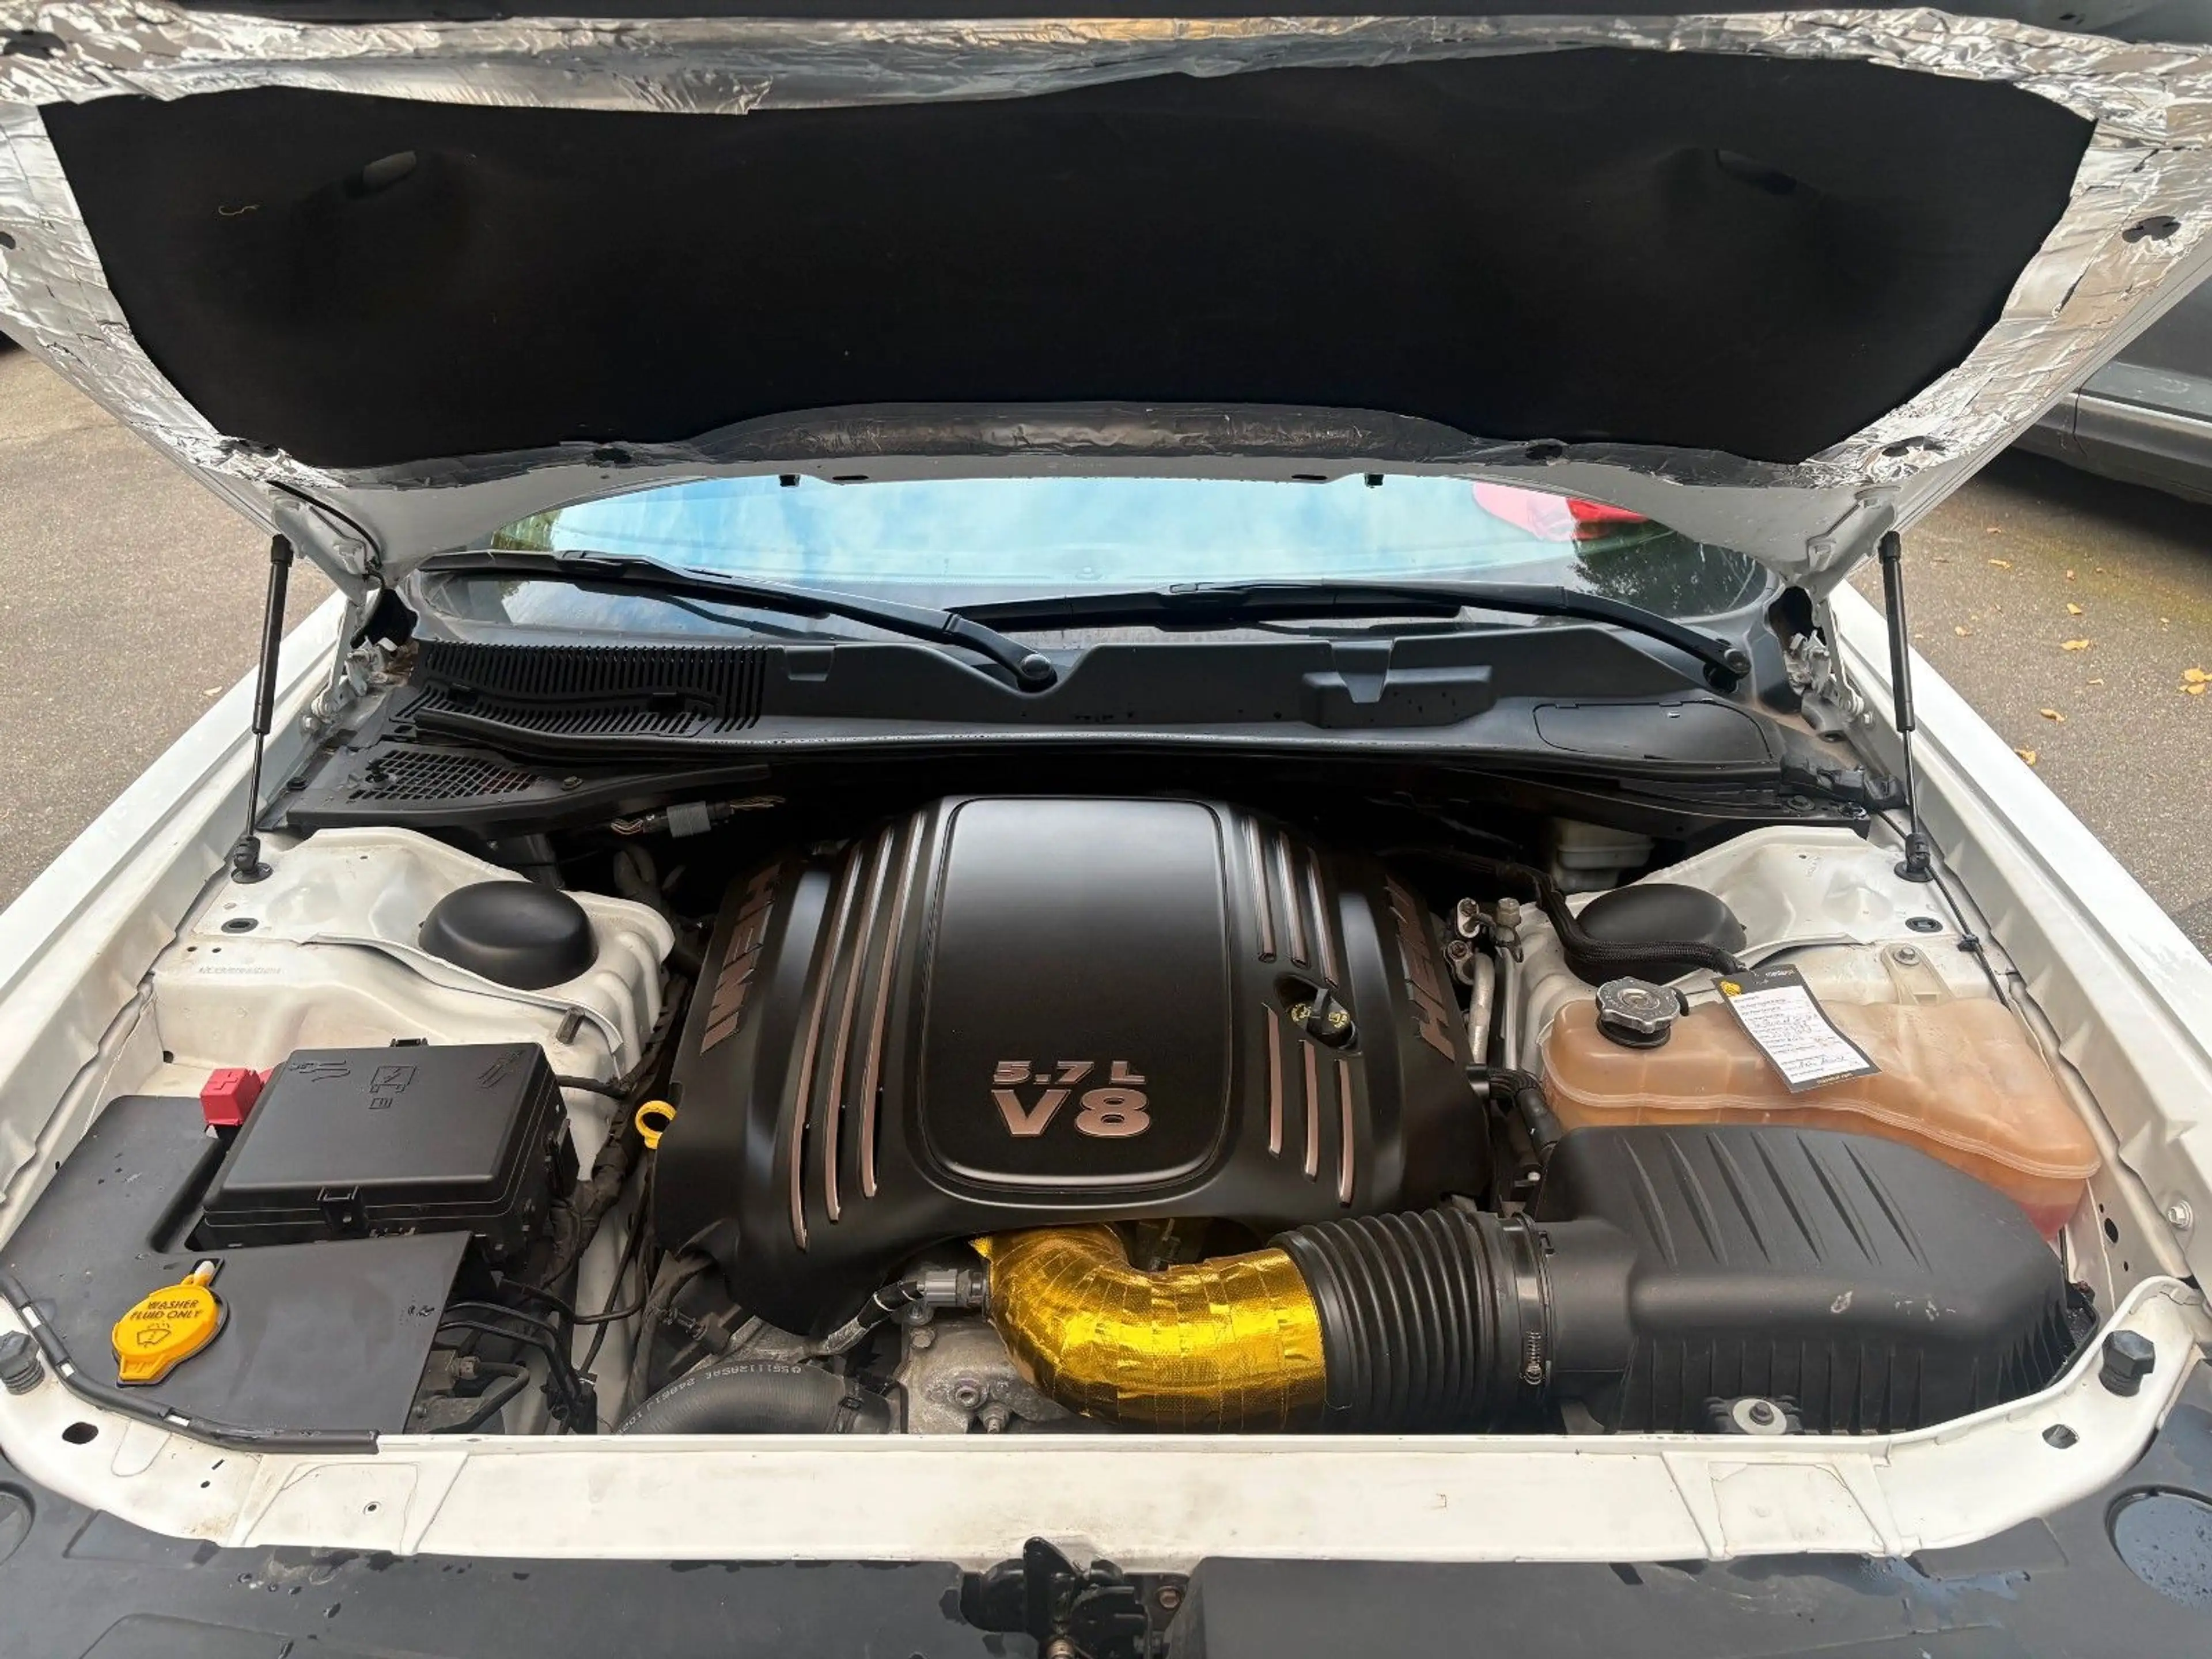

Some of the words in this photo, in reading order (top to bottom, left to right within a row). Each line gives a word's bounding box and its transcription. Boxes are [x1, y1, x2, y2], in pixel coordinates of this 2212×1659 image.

[993, 1060, 1094, 1085] 5.7
[1109, 1060, 1146, 1085] L
[991, 1087, 1152, 1138] V8
[148, 1300, 199, 1309] WASHER
[131, 1310, 165, 1320] FLUID
[168, 1309, 203, 1319] ONLY
